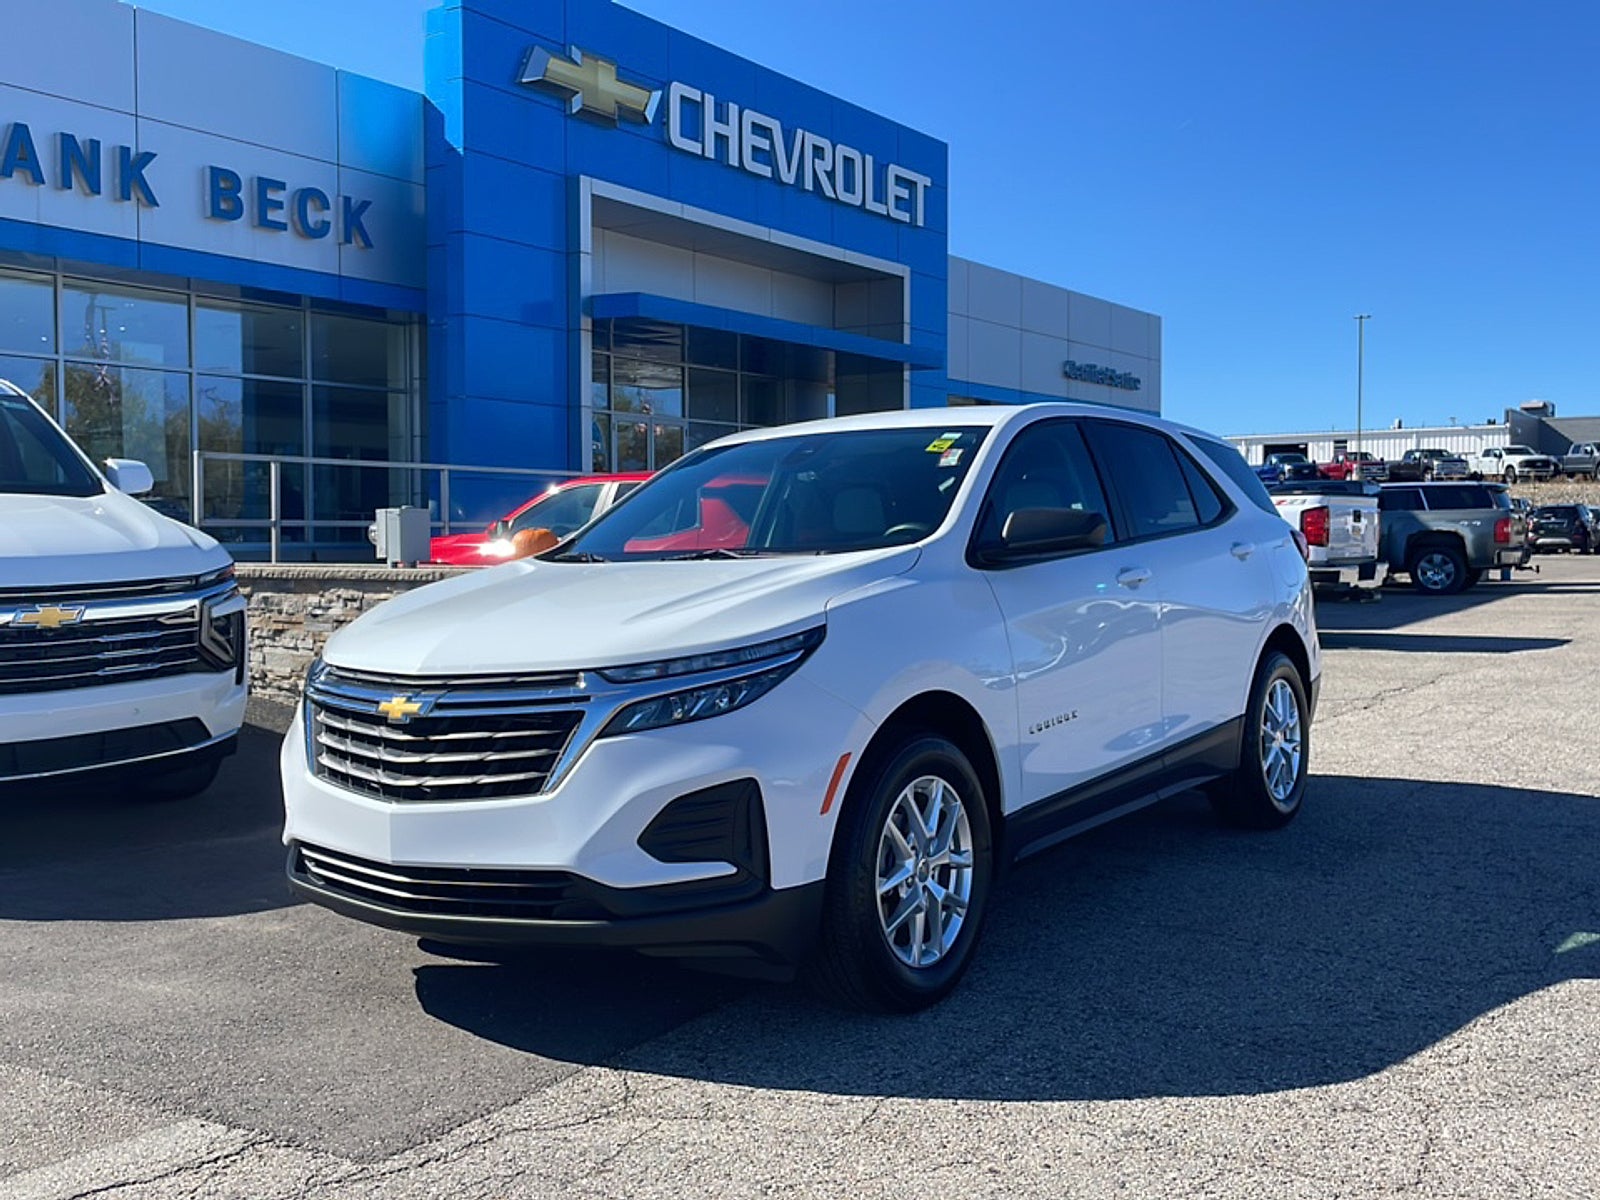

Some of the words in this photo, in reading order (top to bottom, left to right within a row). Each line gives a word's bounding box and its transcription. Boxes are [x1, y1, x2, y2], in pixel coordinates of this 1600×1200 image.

[0, 122, 160, 207] ANK
[204, 165, 374, 249] BECK
[667, 80, 932, 227] CHEVROLET
